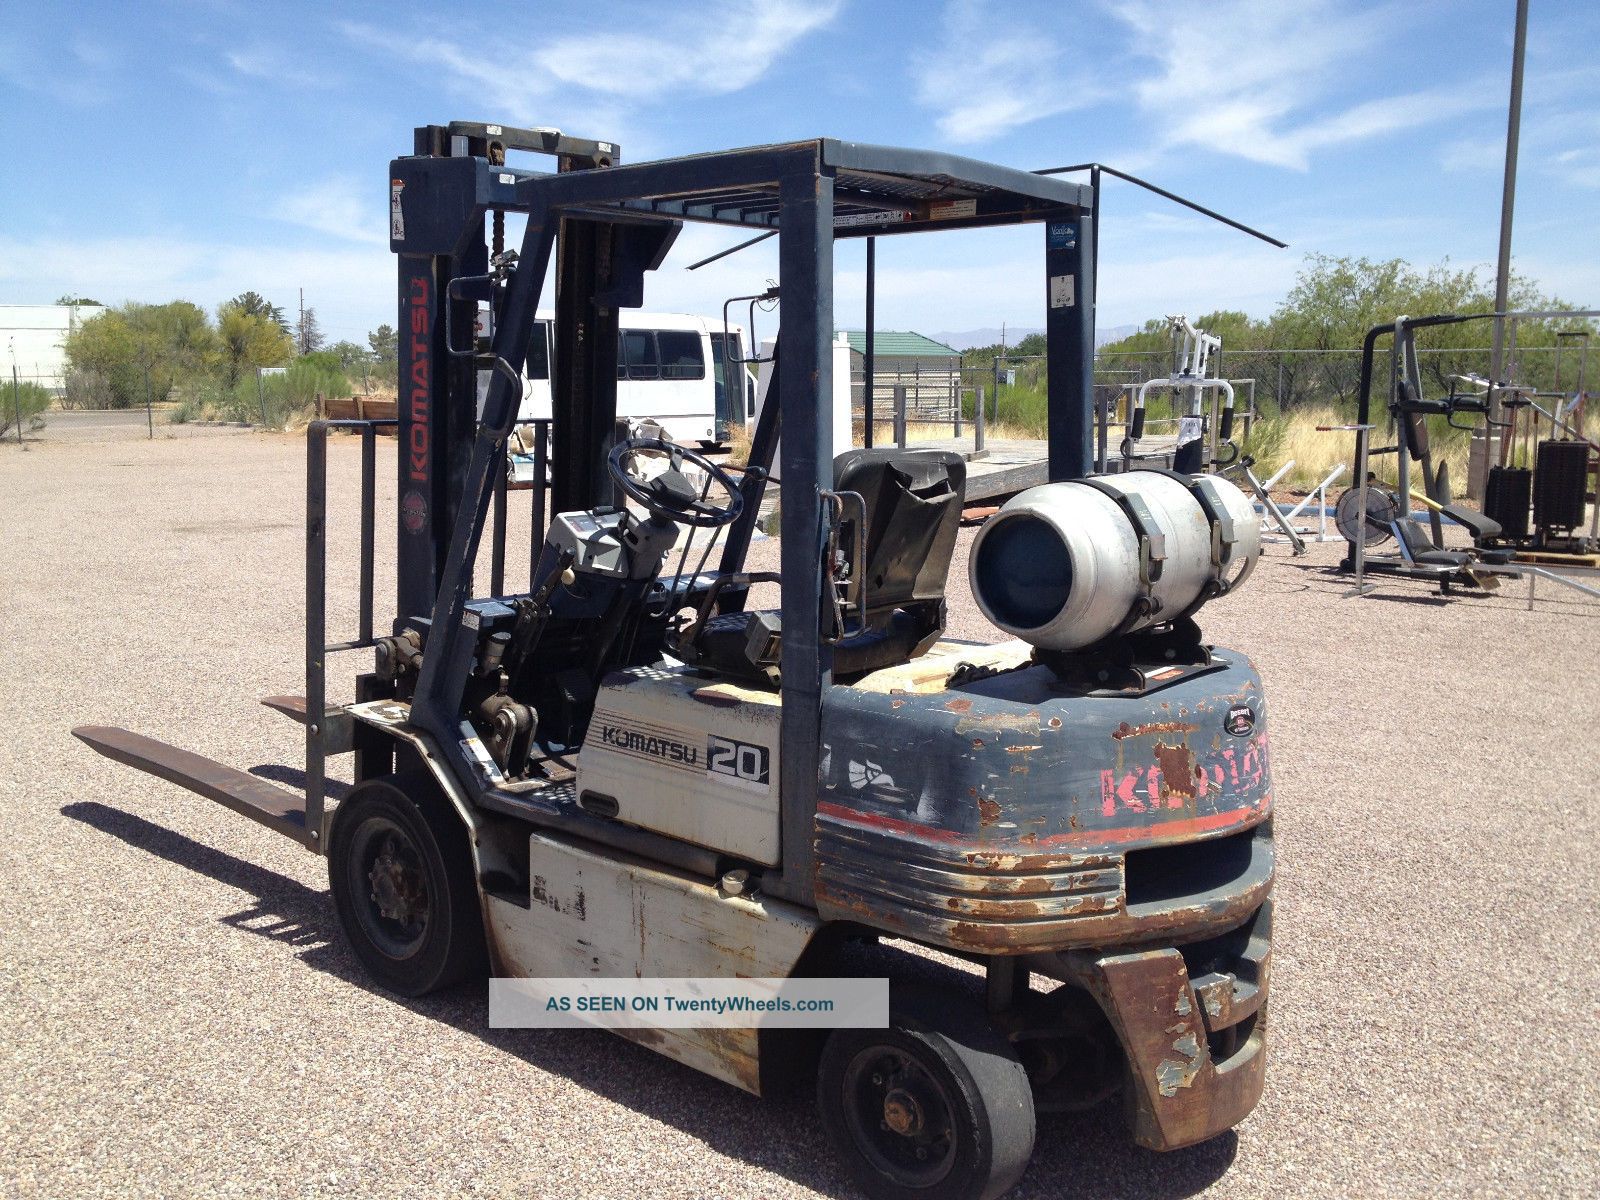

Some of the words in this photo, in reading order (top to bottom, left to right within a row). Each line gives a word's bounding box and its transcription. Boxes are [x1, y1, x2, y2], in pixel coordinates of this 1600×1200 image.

[410, 276, 429, 481] KOMATSU
[602, 725, 697, 765] KOMATSU
[712, 738, 762, 782] 20
